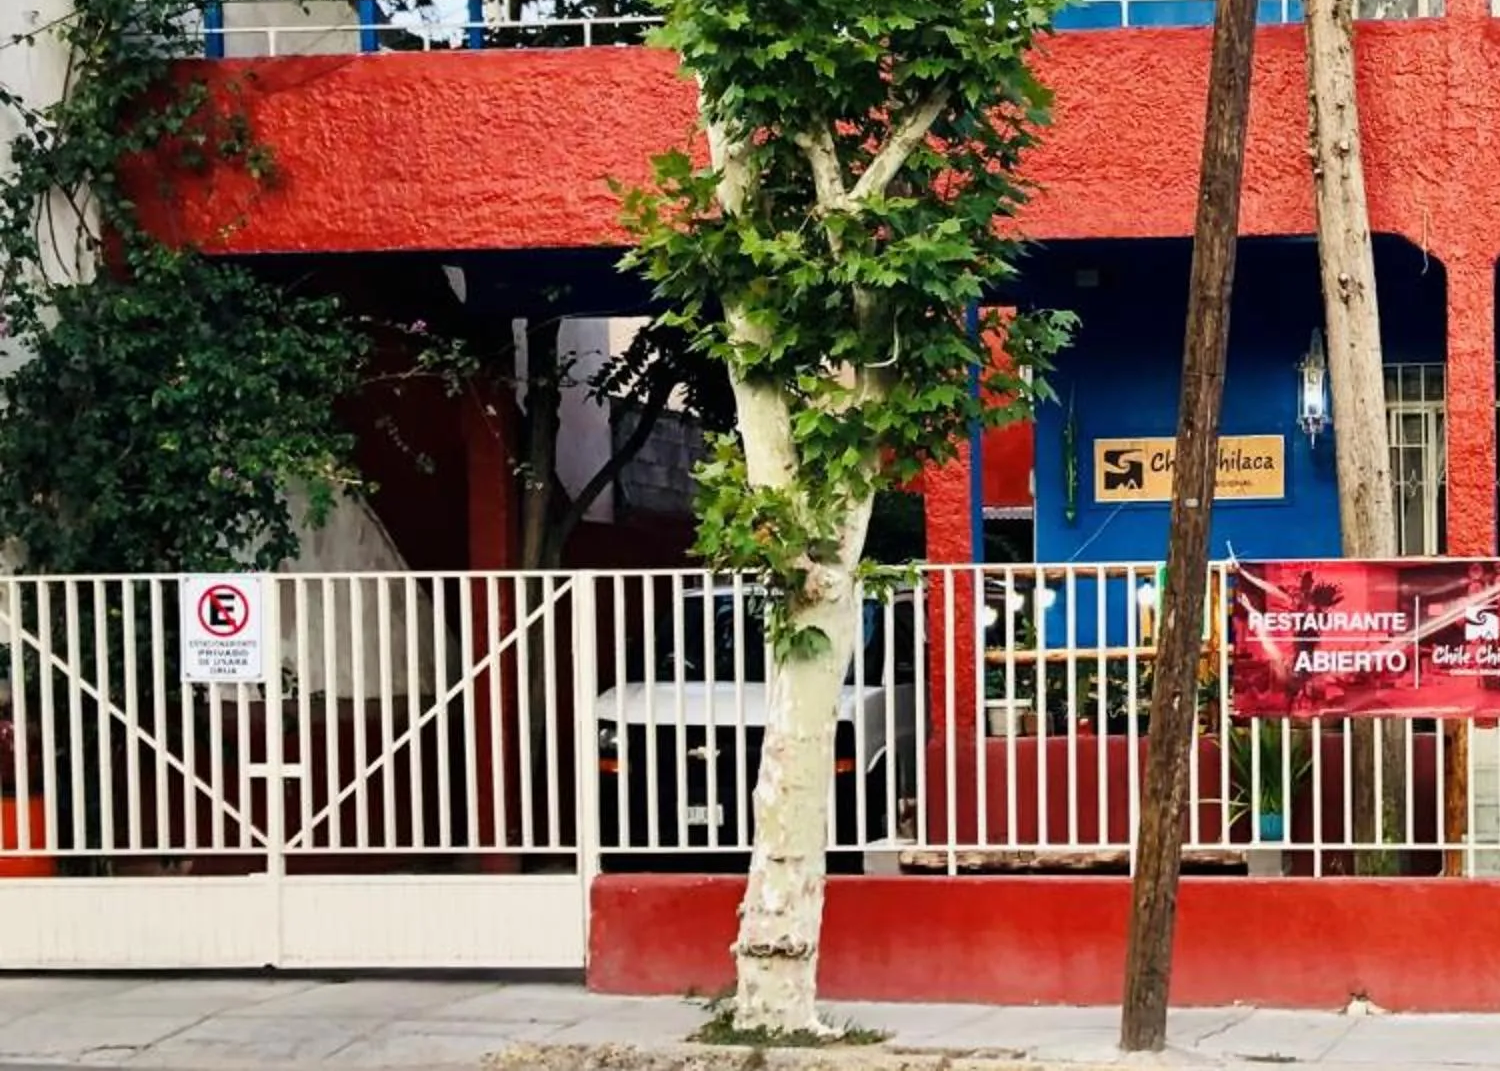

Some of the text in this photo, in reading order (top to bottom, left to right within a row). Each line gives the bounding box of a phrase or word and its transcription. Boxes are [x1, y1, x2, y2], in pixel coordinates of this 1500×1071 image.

[1216, 447, 1275, 473] hilaca
[1247, 612, 1407, 632] RESTAURANTE
[198, 649, 250, 657] PRIVADO
[1293, 651, 1407, 673] ABIERTO
[1432, 644, 1472, 665] Chile
